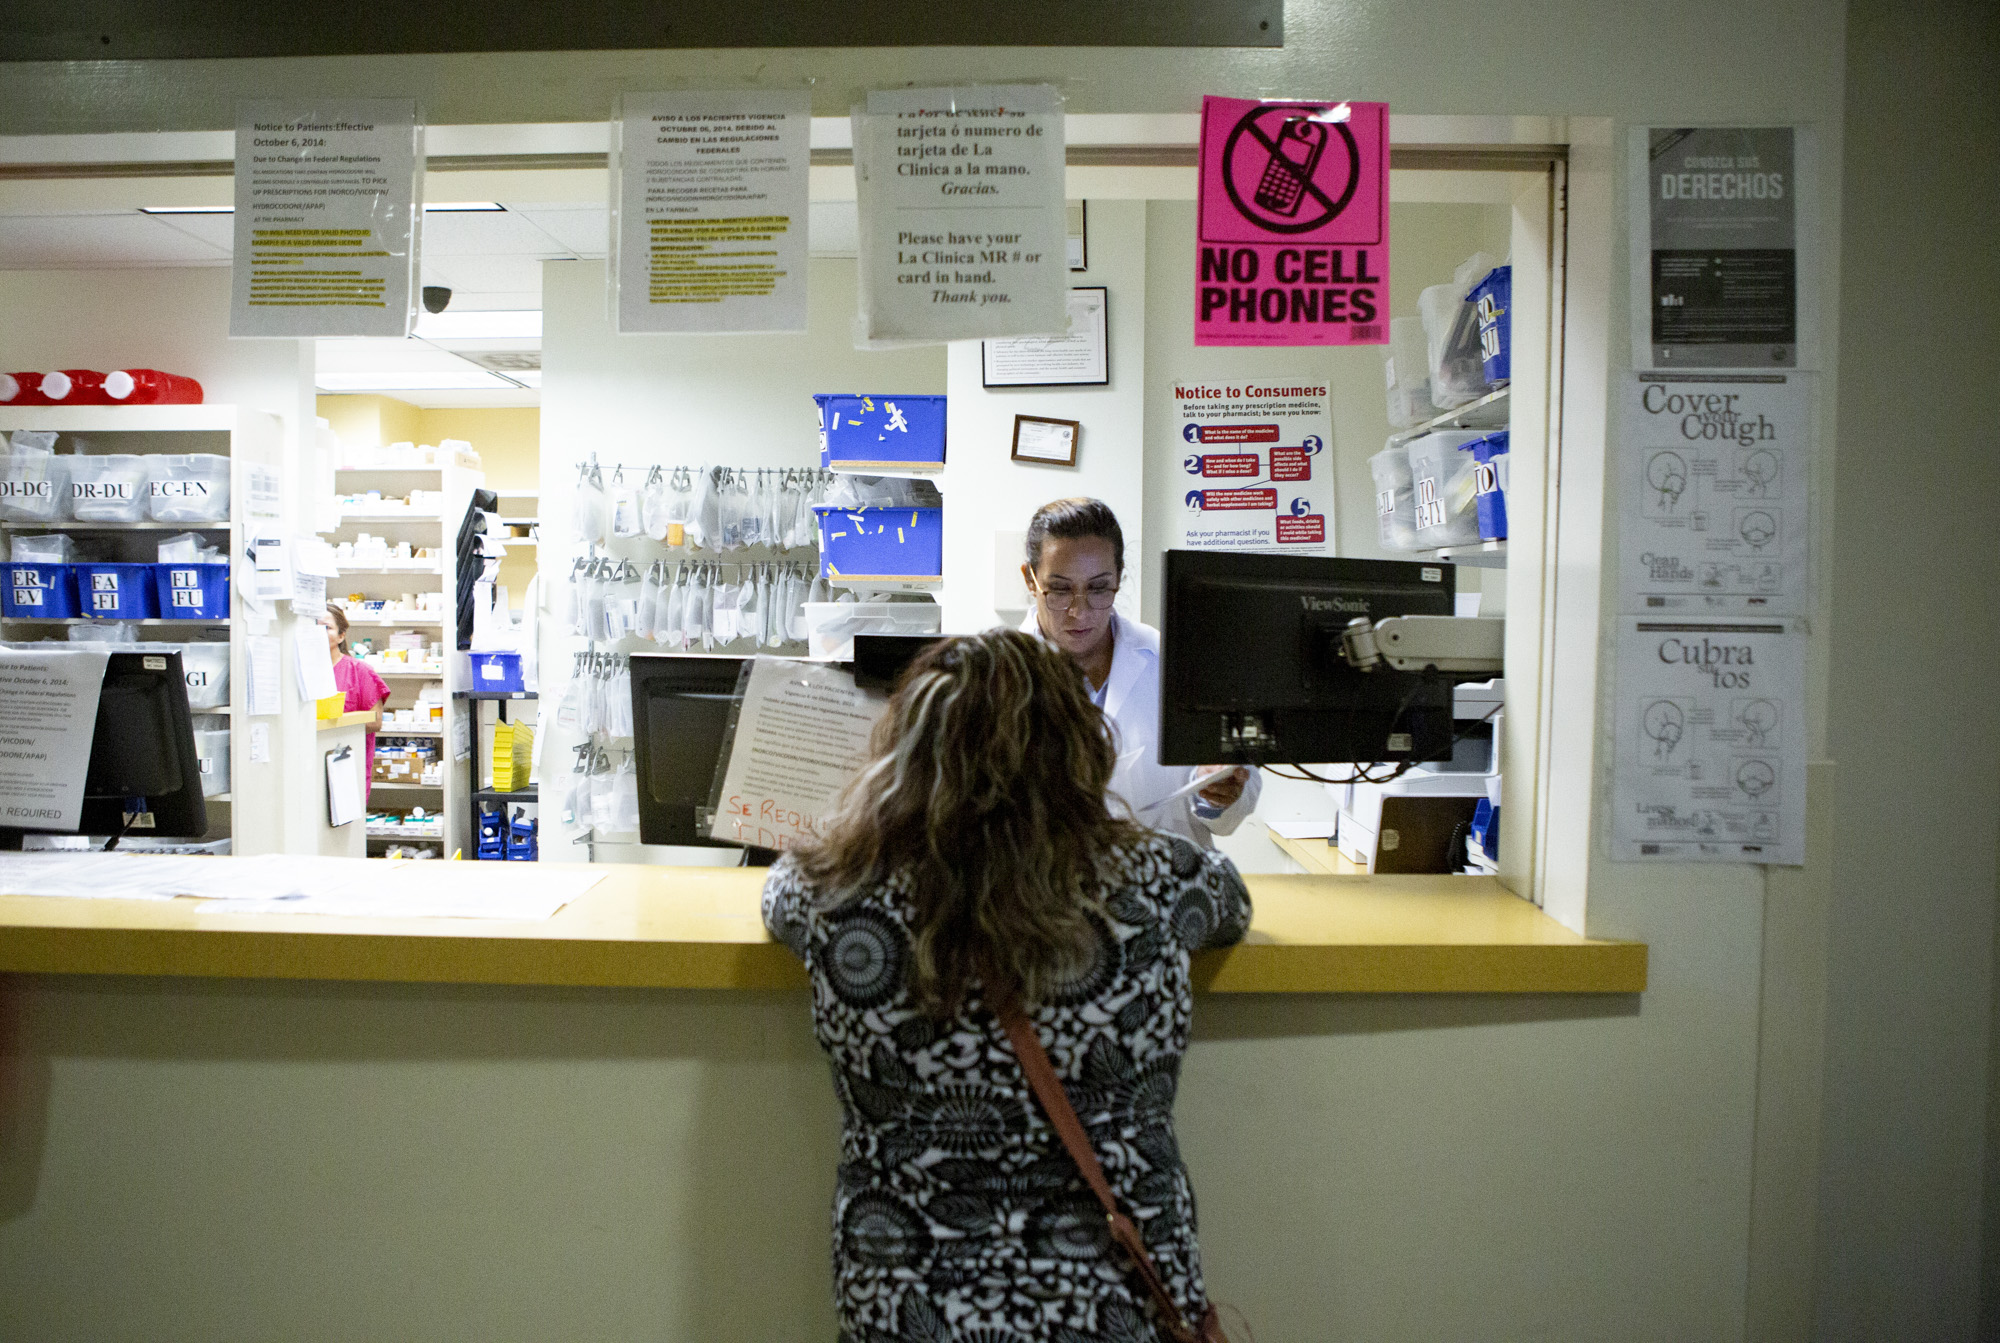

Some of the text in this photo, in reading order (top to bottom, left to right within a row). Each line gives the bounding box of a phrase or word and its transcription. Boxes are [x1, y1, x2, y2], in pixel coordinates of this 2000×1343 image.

[254, 123, 283, 132] Notice
[285, 123, 294, 132] to
[898, 124, 1043, 140] tarjeta ó numero de
[253, 138, 327, 147] October 6, 2014:
[253, 155, 381, 163] Due to Change in Federal Regulations
[898, 144, 992, 159] tarjeta de La
[898, 163, 1030, 176] Clinica a la mano.
[942, 182, 1000, 195] Gracias.
[1661, 173, 1783, 200] DERECHOS
[898, 232, 1021, 250] Please have your
[898, 251, 917, 264] La
[922, 251, 974, 264] Clinica
[979, 251, 1007, 264] MR
[1026, 253, 1042, 263] or
[1201, 248, 1379, 284] NO CELL
[898, 271, 996, 283] card in hand.
[931, 291, 1012, 307] Thank you.
[1201, 288, 1377, 324] PHONES
[1175, 384, 1327, 399] Notice to Consumers
[1643, 384, 1739, 414] Cover
[1184, 401, 1321, 412] Before taking any prescription medicine,
[1206, 410, 1221, 418] your
[1223, 410, 1261, 418] pharmacist;
[1287, 409, 1300, 417] you
[1188, 427, 1200, 442] 1
[1681, 414, 1776, 447] Cough
[1304, 436, 1318, 456] 3
[1184, 455, 1198, 471] 2
[72, 484, 130, 498] DR-DU
[150, 482, 208, 496] EC-EN
[1419, 480, 1434, 504] TO
[1297, 498, 1309, 518] 5
[1186, 530, 1198, 538] Ask
[1199, 530, 1214, 538] your
[1215, 530, 1251, 538] pharmacist
[13, 572, 38, 586] ER
[92, 575, 116, 590] FA
[172, 572, 196, 587] FL
[14, 590, 40, 604] EV
[1301, 596, 1370, 613] ViewSonic
[1659, 638, 1754, 664] Cubra
[1714, 668, 1750, 689] tos
[7, 807, 62, 819] REQUIRED
